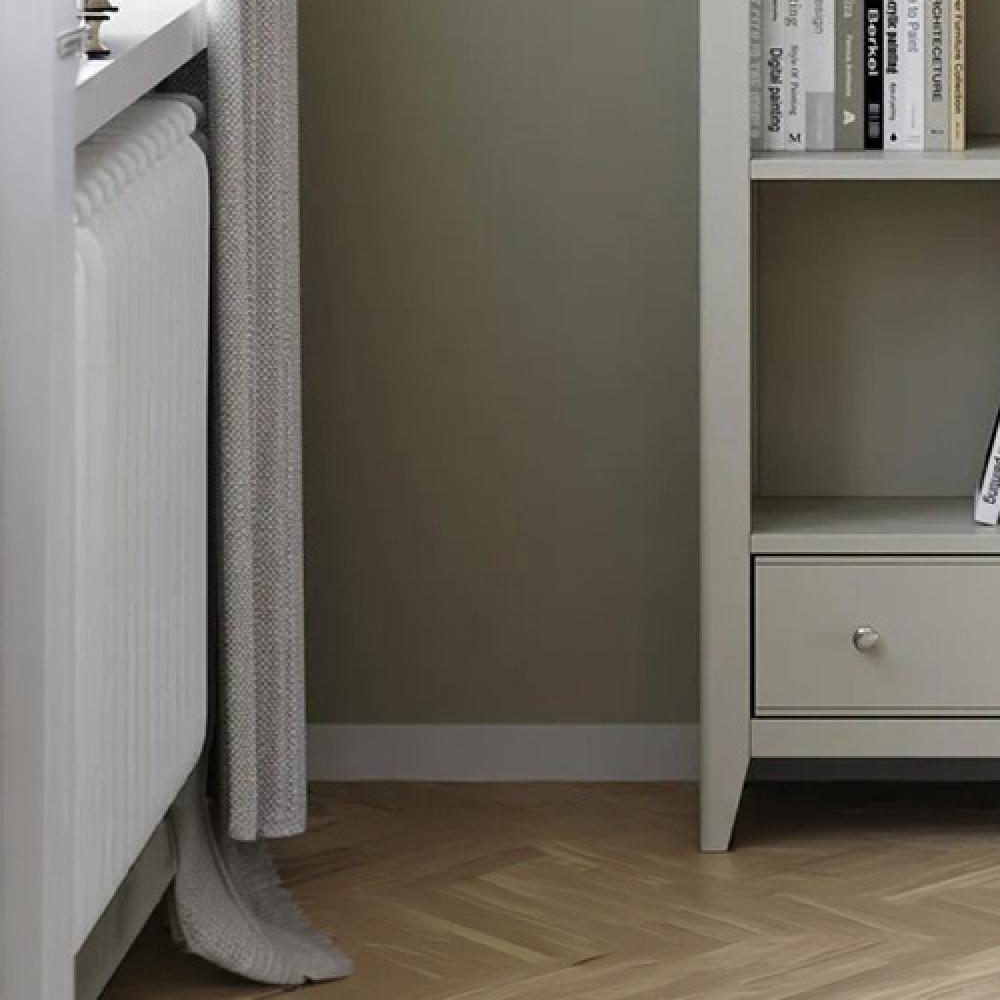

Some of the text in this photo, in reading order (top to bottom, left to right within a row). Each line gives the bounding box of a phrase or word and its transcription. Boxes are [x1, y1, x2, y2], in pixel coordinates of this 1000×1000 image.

[907, 7, 920, 18] to
[868, 9, 879, 76] Berkel
[907, 22, 920, 53] Paint
[767, 48, 783, 132] Digital painting
